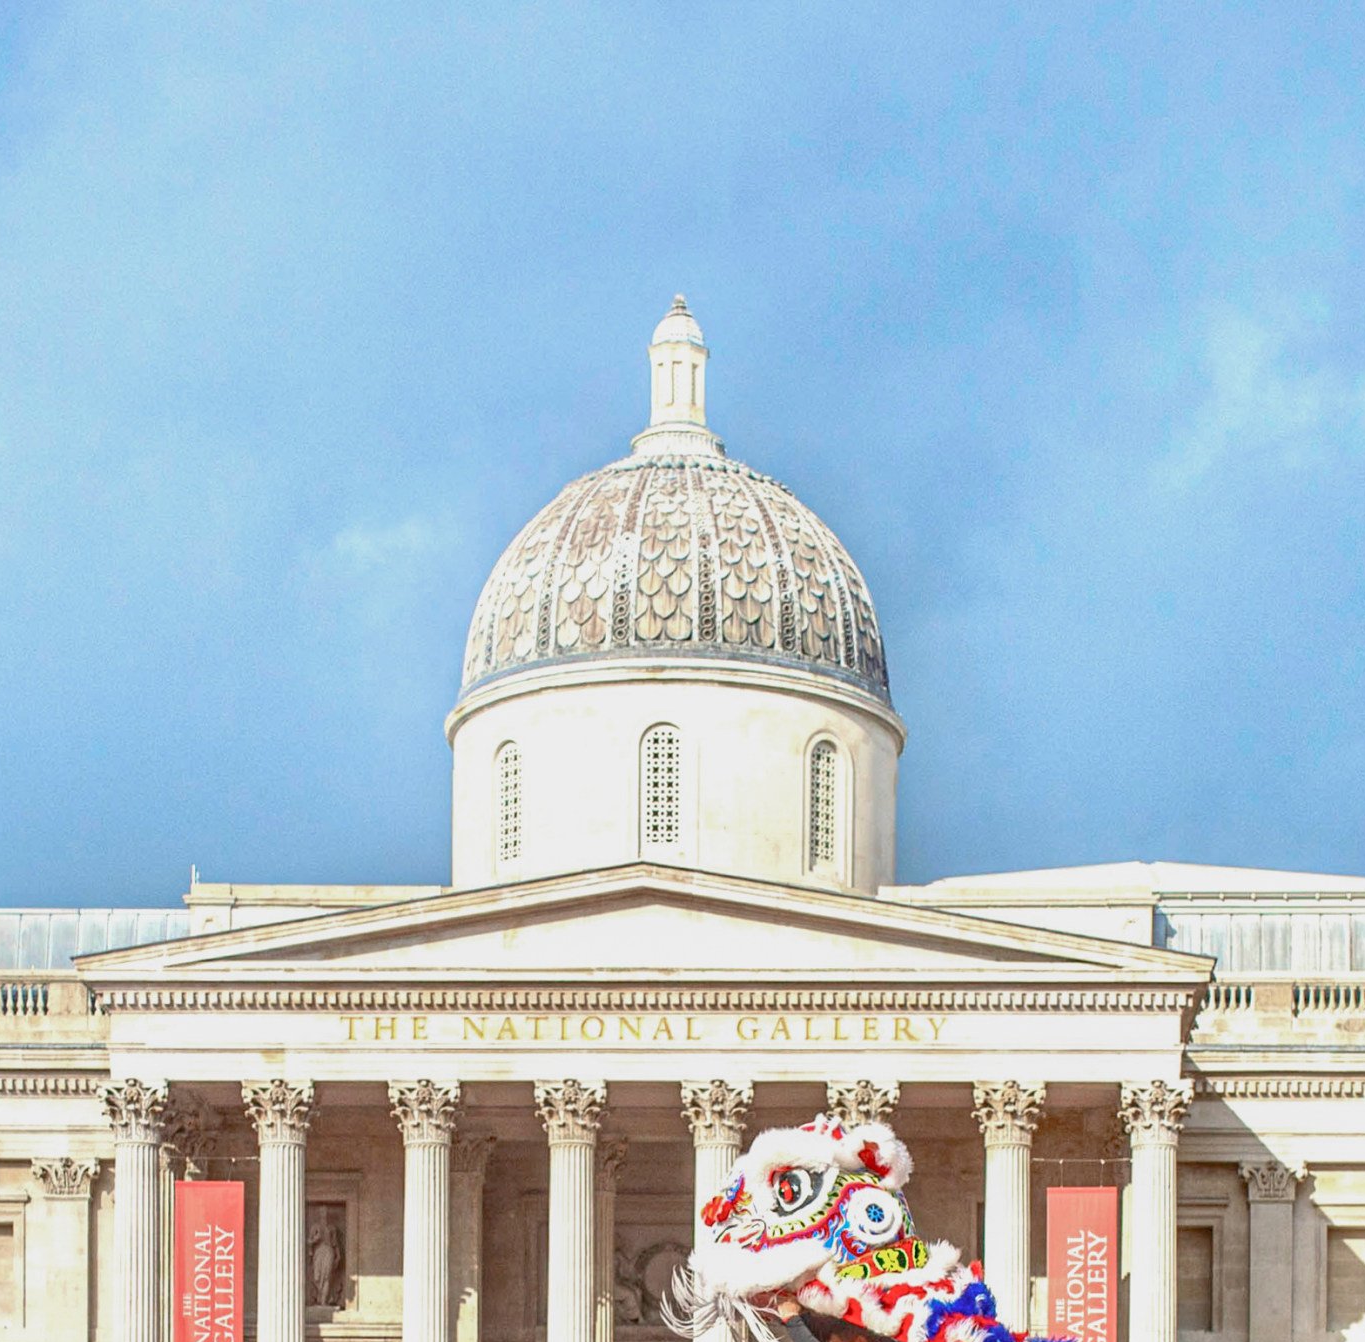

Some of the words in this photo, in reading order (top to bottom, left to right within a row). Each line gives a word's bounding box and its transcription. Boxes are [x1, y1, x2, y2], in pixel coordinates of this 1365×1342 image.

[340, 1016, 429, 1041] THE
[463, 1016, 702, 1041] NATIONAL
[736, 1016, 948, 1041] GALLERY
[183, 1292, 192, 1317] THE
[1055, 1298, 1065, 1322] THE
